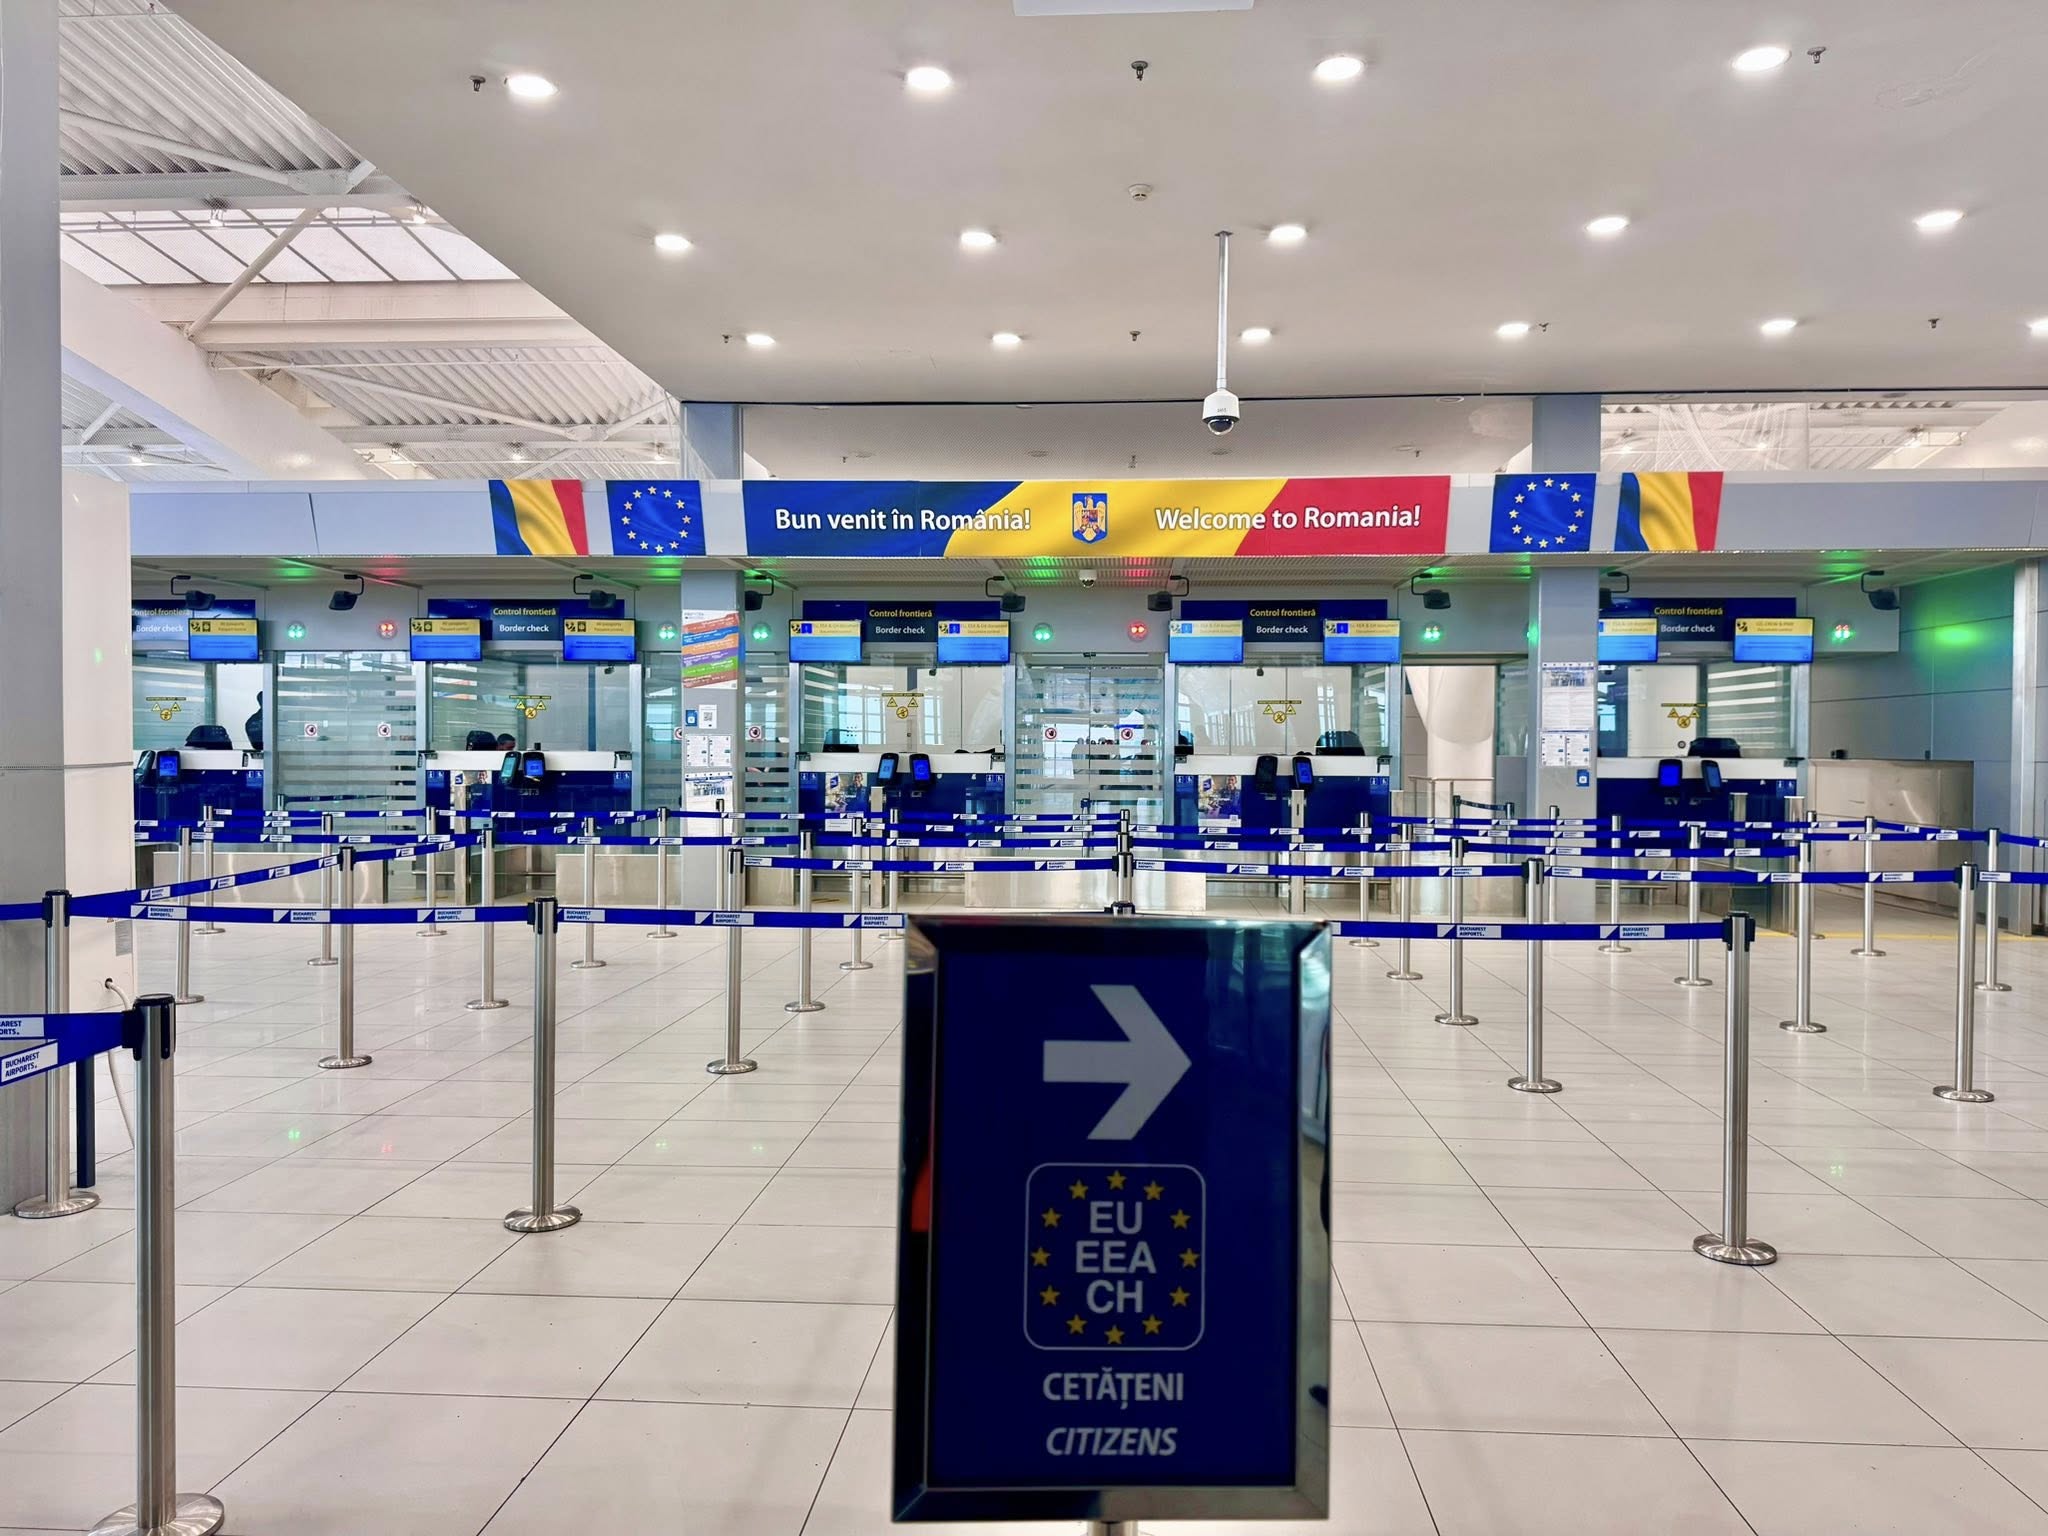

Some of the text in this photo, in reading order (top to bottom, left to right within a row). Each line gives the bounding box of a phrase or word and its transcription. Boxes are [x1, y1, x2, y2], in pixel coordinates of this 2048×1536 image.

[775, 508, 1031, 530] Bun venit în România!
[1155, 505, 1421, 530] Welcome to Romania!
[493, 606, 556, 616] Control frontieră
[869, 608, 933, 618] Control frontieră
[1250, 608, 1316, 617] Control frontieră
[1654, 606, 1723, 616] Control frontieră
[136, 624, 184, 633] Border check
[499, 624, 549, 632] Border check
[875, 626, 925, 635] Border check
[1256, 625, 1308, 634] Border check
[1660, 624, 1689, 633] Border
[1691, 624, 1715, 633] check
[6, 1052, 40, 1068] BUCHAREST
[6, 1062, 37, 1077] AIRPORTS.
[1089, 1200, 1143, 1235] EU
[1075, 1240, 1157, 1274] EEA
[1086, 1279, 1144, 1314] CH
[1042, 1366, 1184, 1410] CETĂȚENI
[1045, 1427, 1178, 1456] CITIZENS
